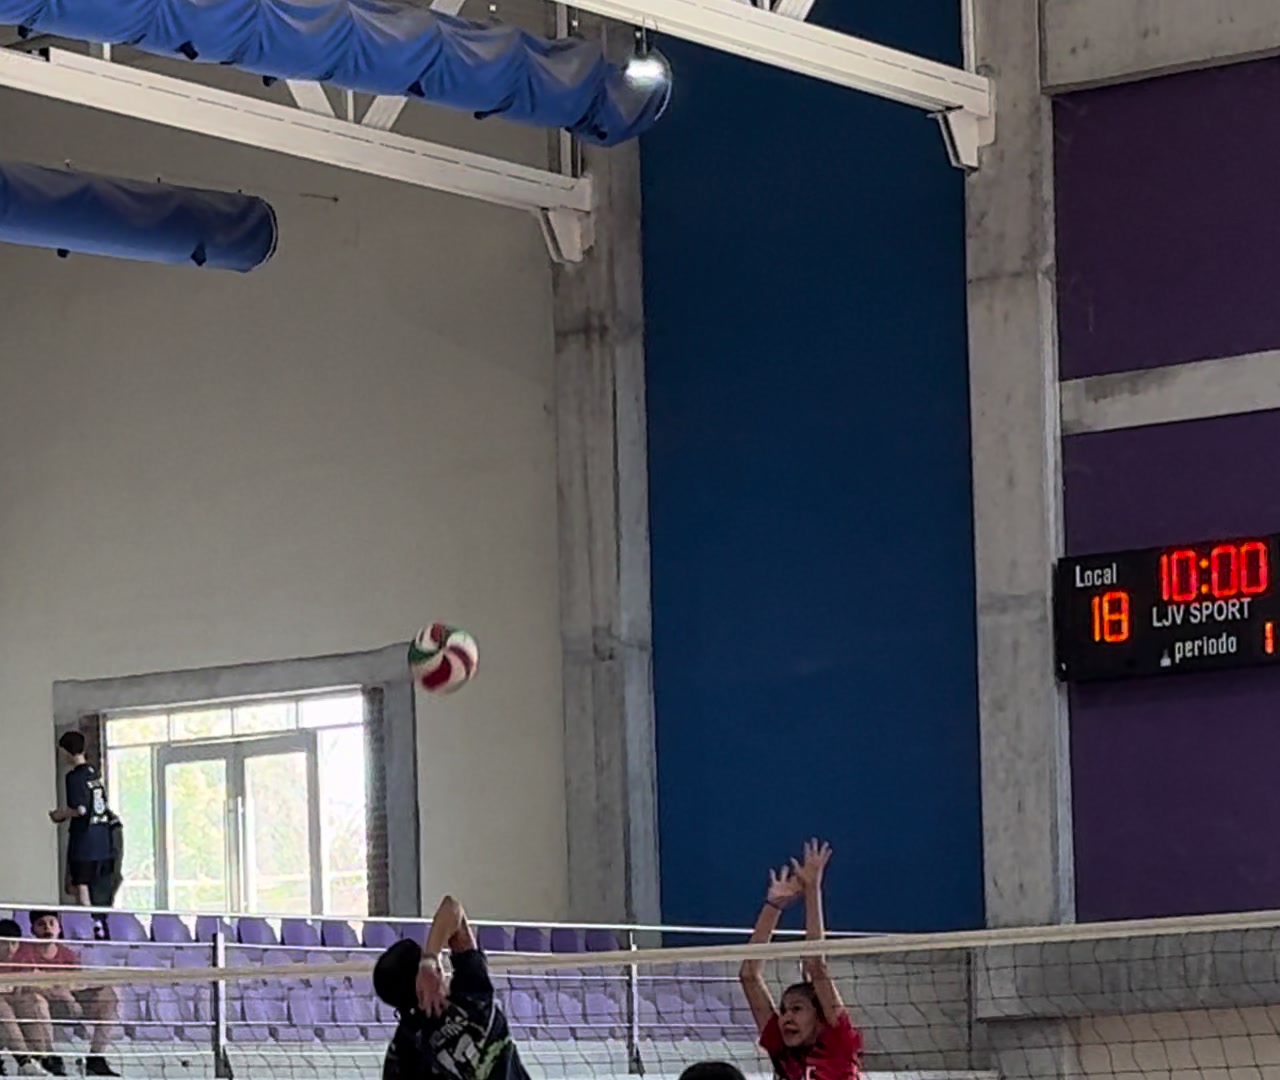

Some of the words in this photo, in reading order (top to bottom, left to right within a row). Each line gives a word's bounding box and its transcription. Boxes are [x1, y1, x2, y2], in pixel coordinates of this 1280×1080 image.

[1075, 562, 1117, 588] Local
[1161, 541, 1269, 601] 10:00
[1092, 591, 1129, 642] 18
[1151, 603, 1184, 627] LJV
[1189, 597, 1252, 624] SPORT
[1174, 631, 1237, 664] periodo
[1265, 621, 1273, 654] 1
